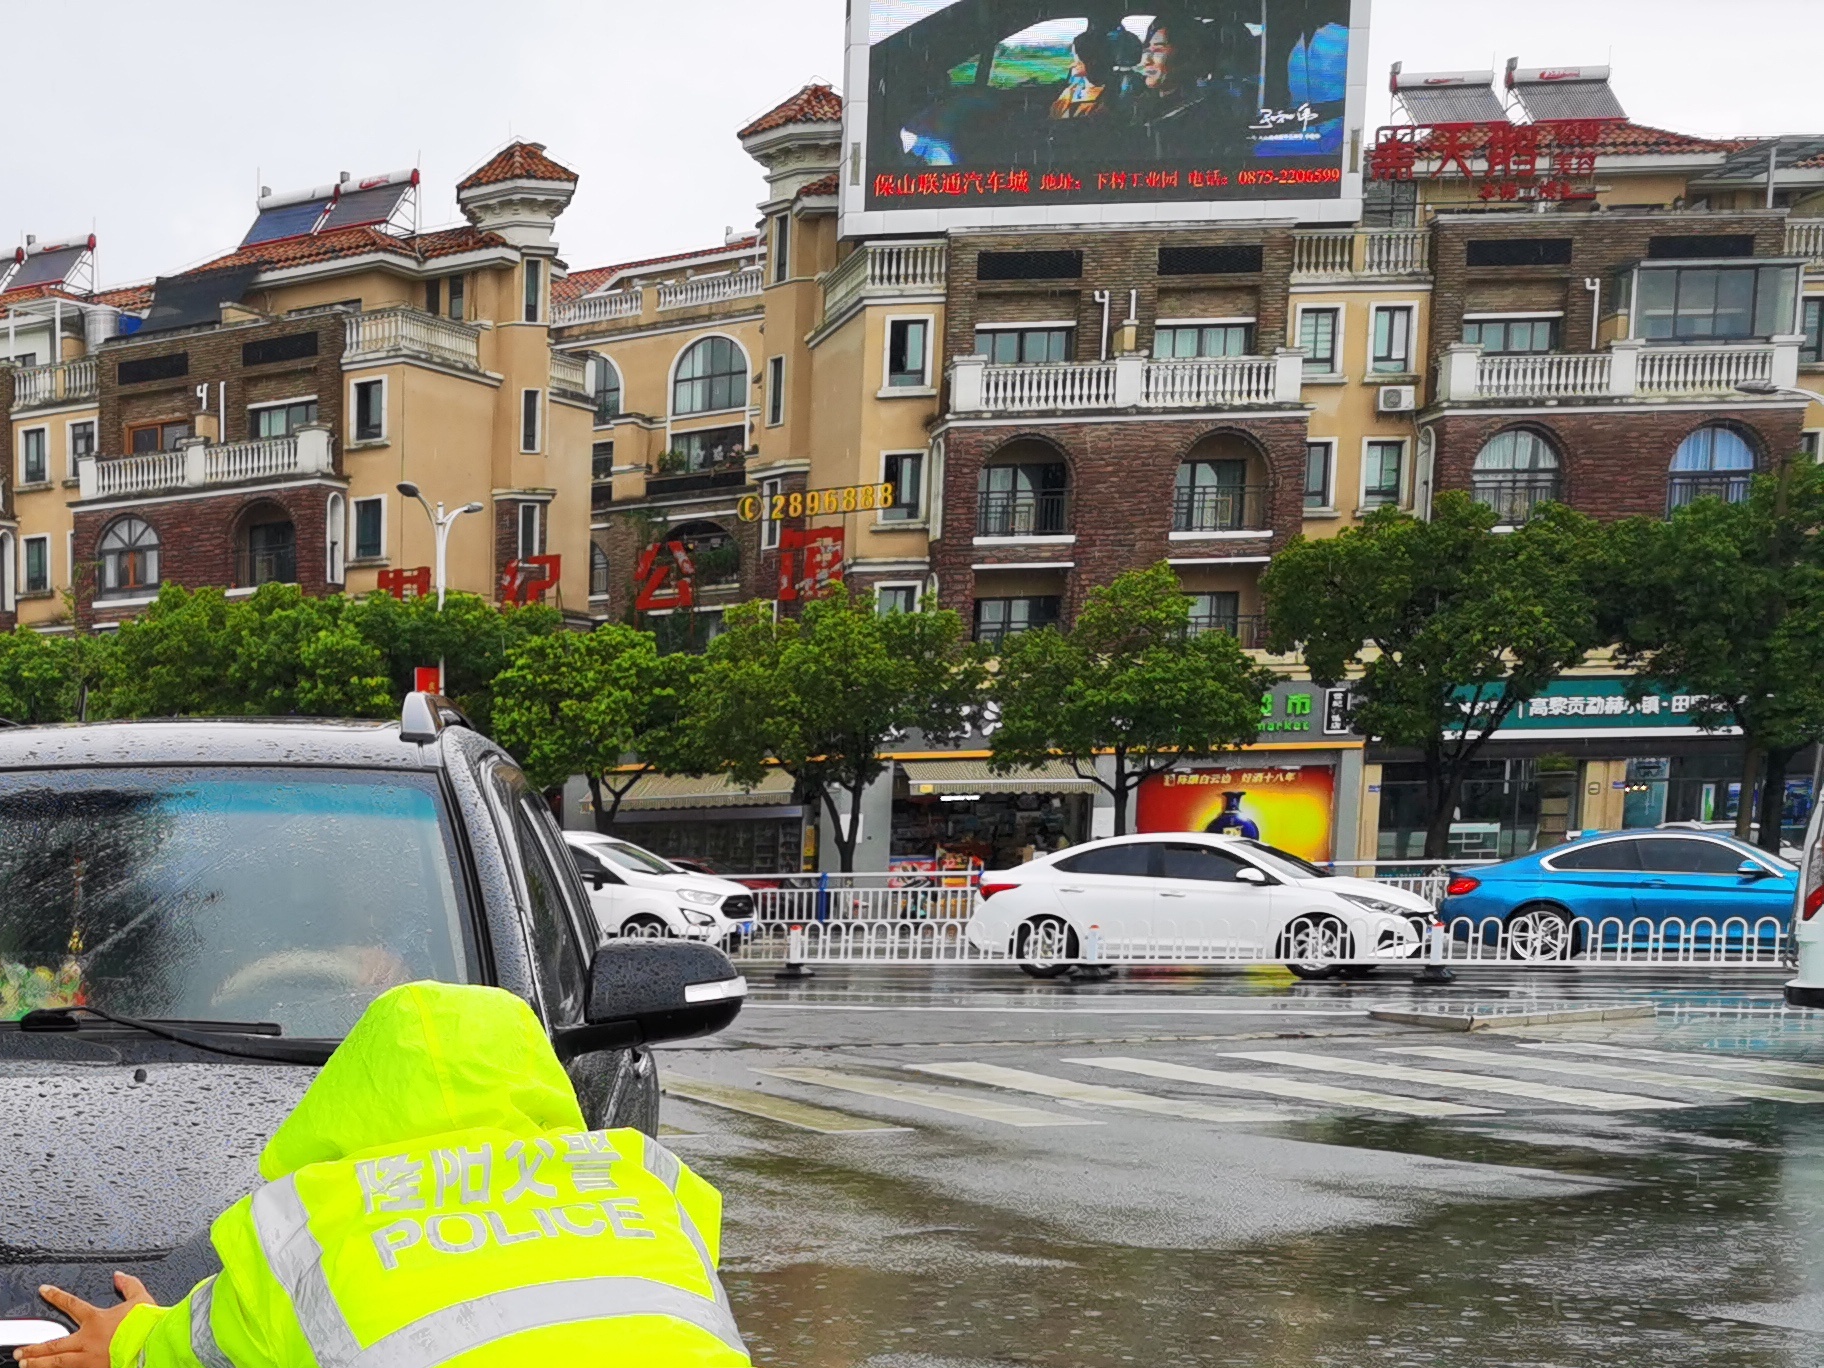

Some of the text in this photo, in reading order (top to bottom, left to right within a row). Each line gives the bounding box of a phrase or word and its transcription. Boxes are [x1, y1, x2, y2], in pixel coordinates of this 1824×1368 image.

[874, 169, 1030, 197] 保山联通汽车城
[771, 483, 893, 520] 2896888
[355, 1131, 622, 1214] 隆阳交警
[371, 1197, 656, 1270] POLICE
